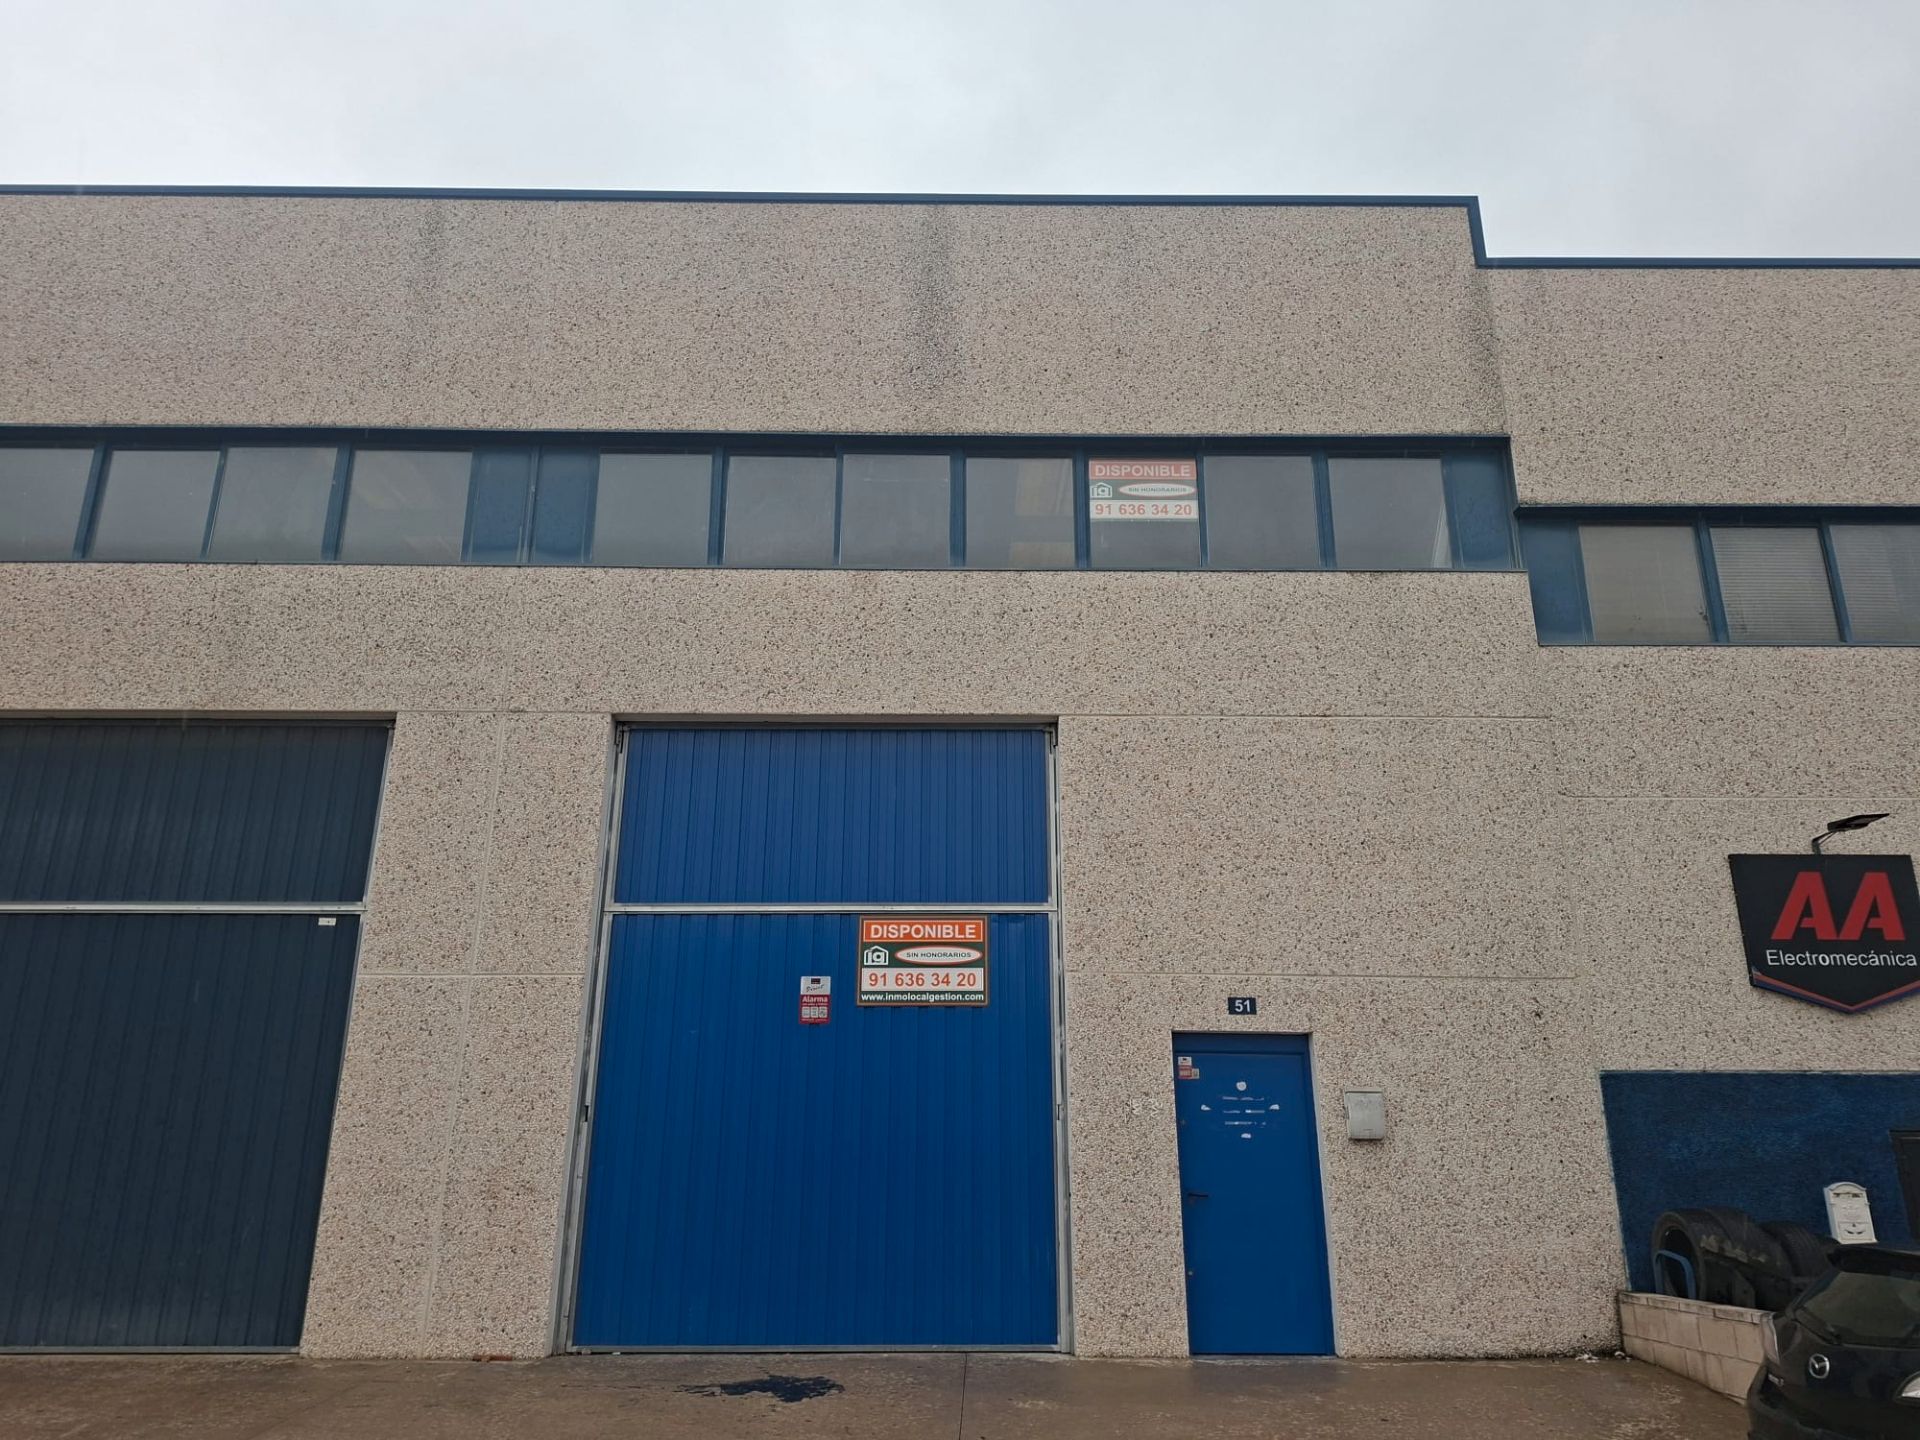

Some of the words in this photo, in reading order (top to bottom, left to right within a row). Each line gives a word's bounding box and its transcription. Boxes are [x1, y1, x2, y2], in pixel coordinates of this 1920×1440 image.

[1095, 465, 1191, 477] DISPONIBLE
[1095, 504, 1112, 515] 91
[1119, 504, 1145, 515] 636
[1151, 504, 1168, 515] 34
[1174, 504, 1192, 515] 20
[1770, 871, 1906, 941] AA
[870, 924, 976, 939] DISPONIBLE
[1765, 949, 1918, 967] Electromecánica
[868, 973, 887, 987] 91
[895, 973, 925, 987] 636
[931, 973, 951, 987] 34
[957, 973, 976, 987] 20
[861, 992, 984, 1002] www.inmolocalgestion.com
[1235, 999, 1251, 1012] 51
